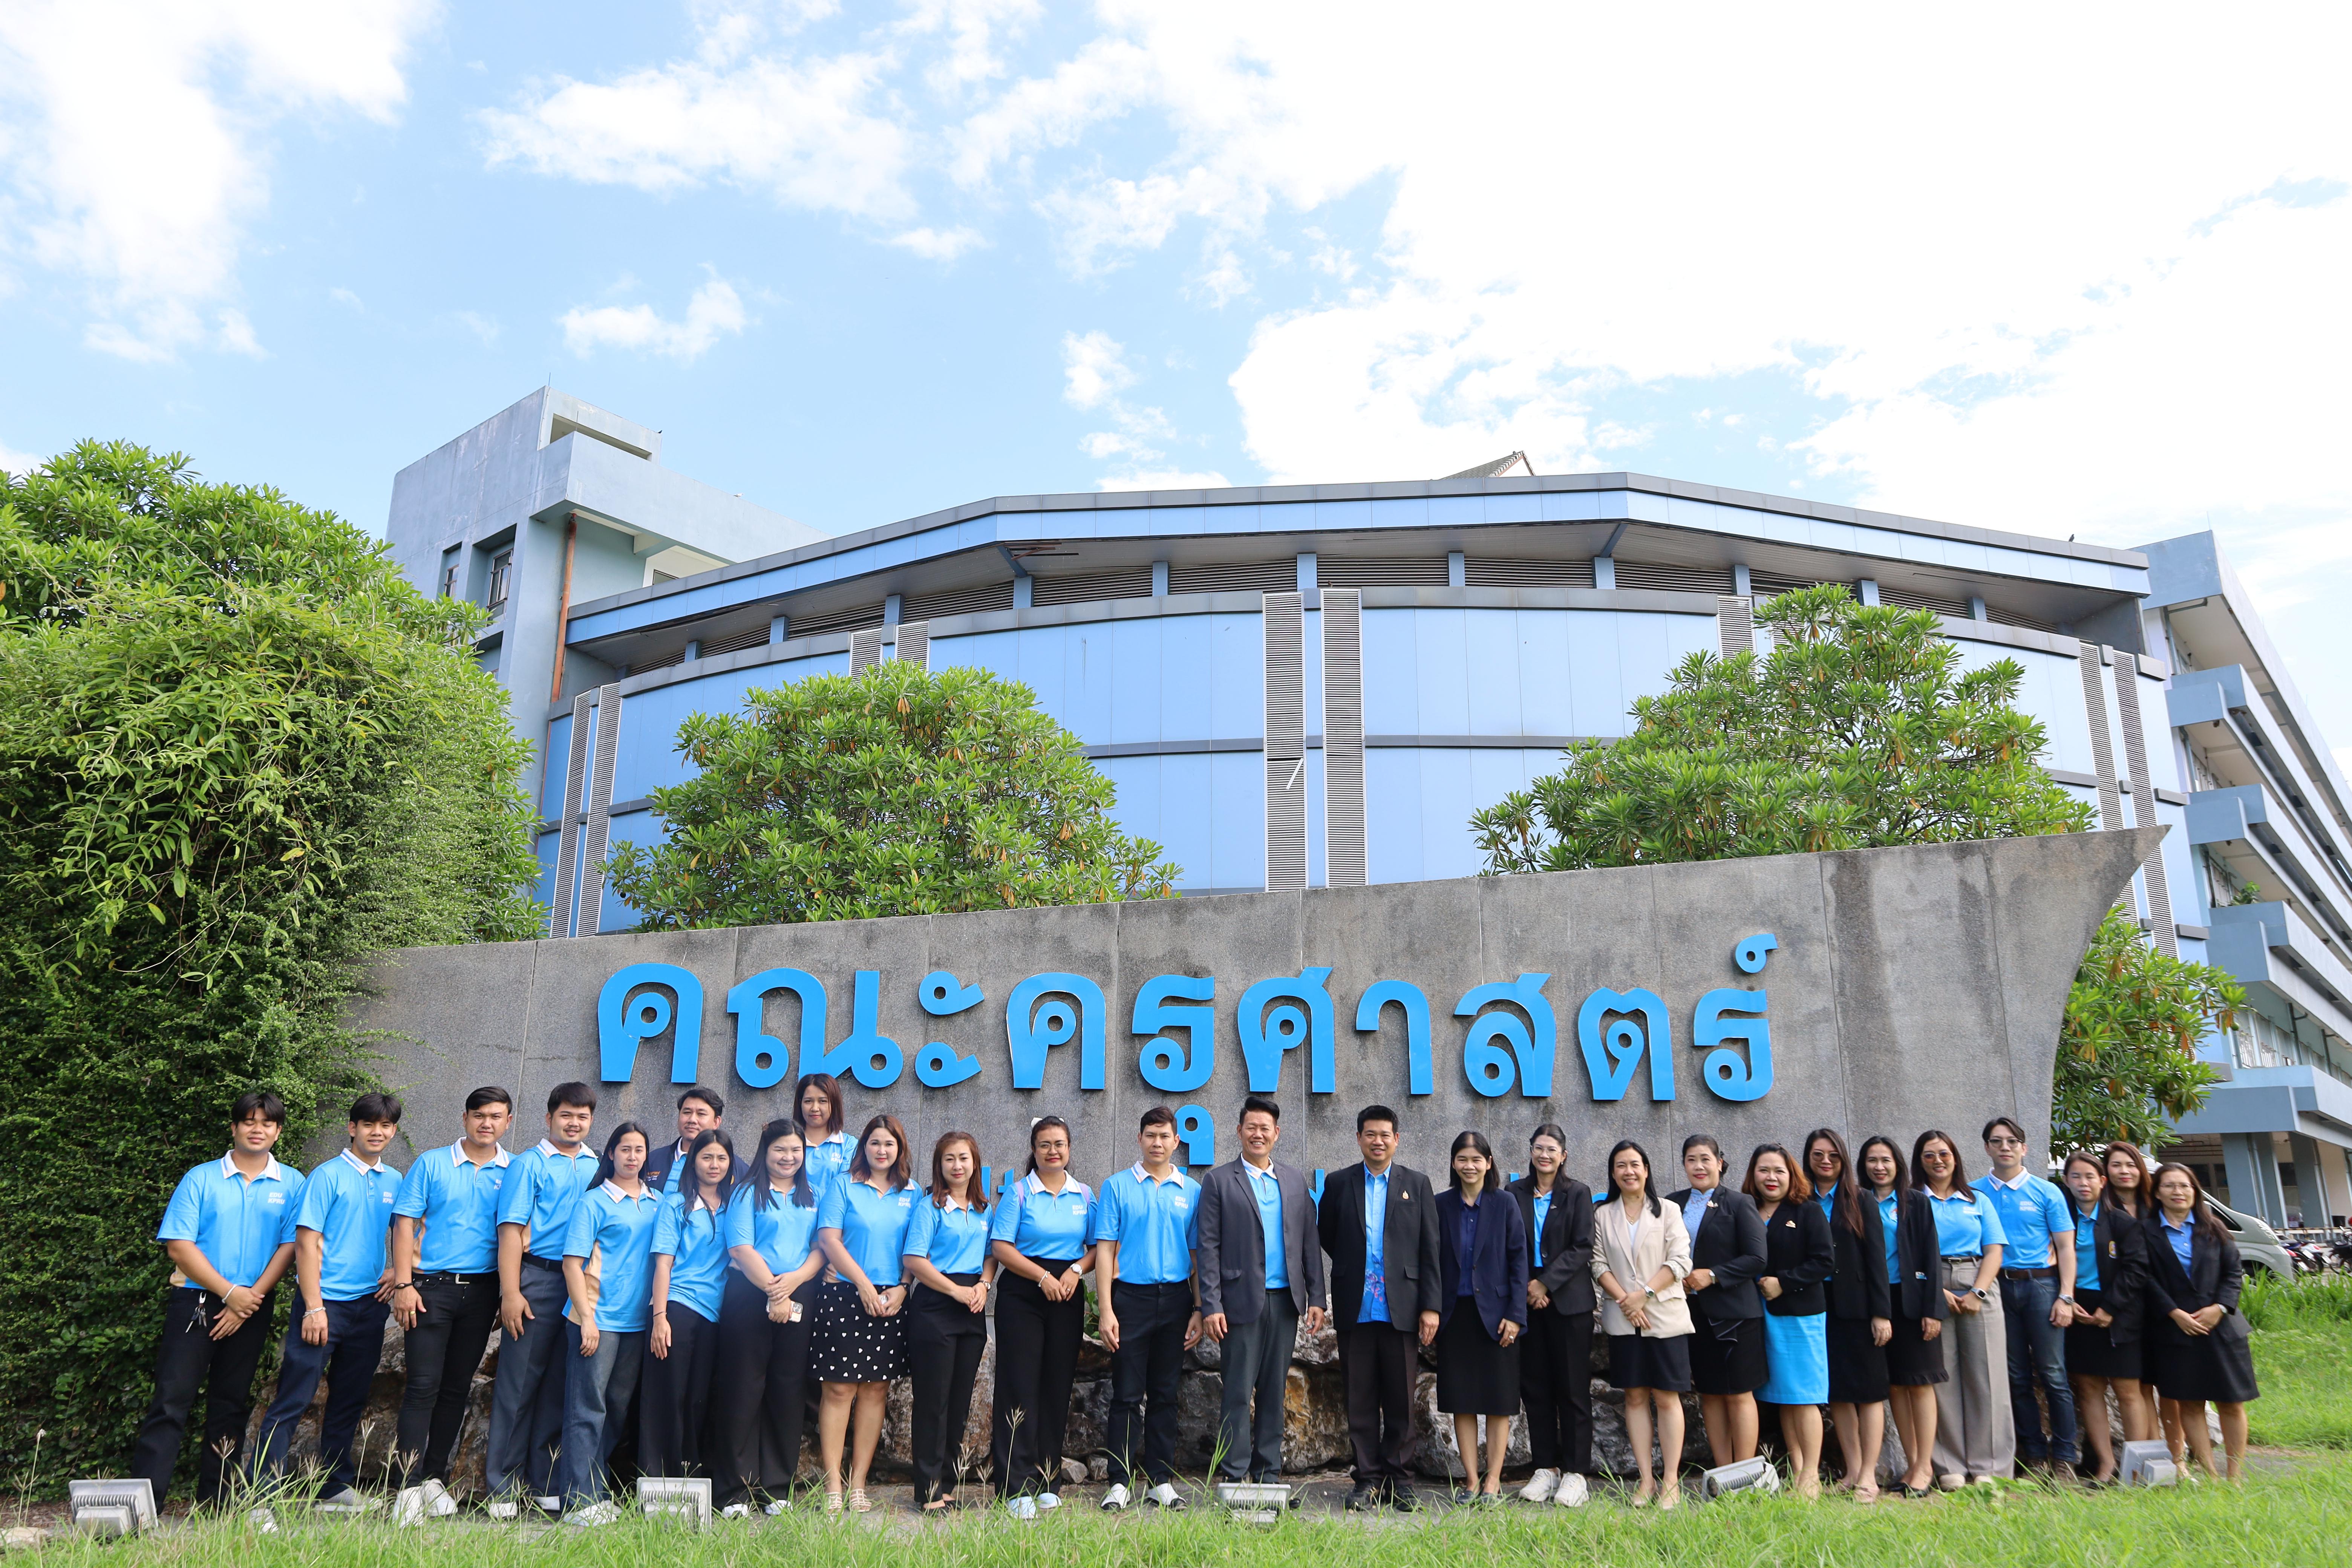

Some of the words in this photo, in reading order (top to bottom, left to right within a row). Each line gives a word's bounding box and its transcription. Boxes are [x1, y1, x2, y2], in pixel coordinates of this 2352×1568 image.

[598, 934, 1777, 1165] คณะครุศาสตร์
[1174, 1201, 1188, 1209] KPRU
